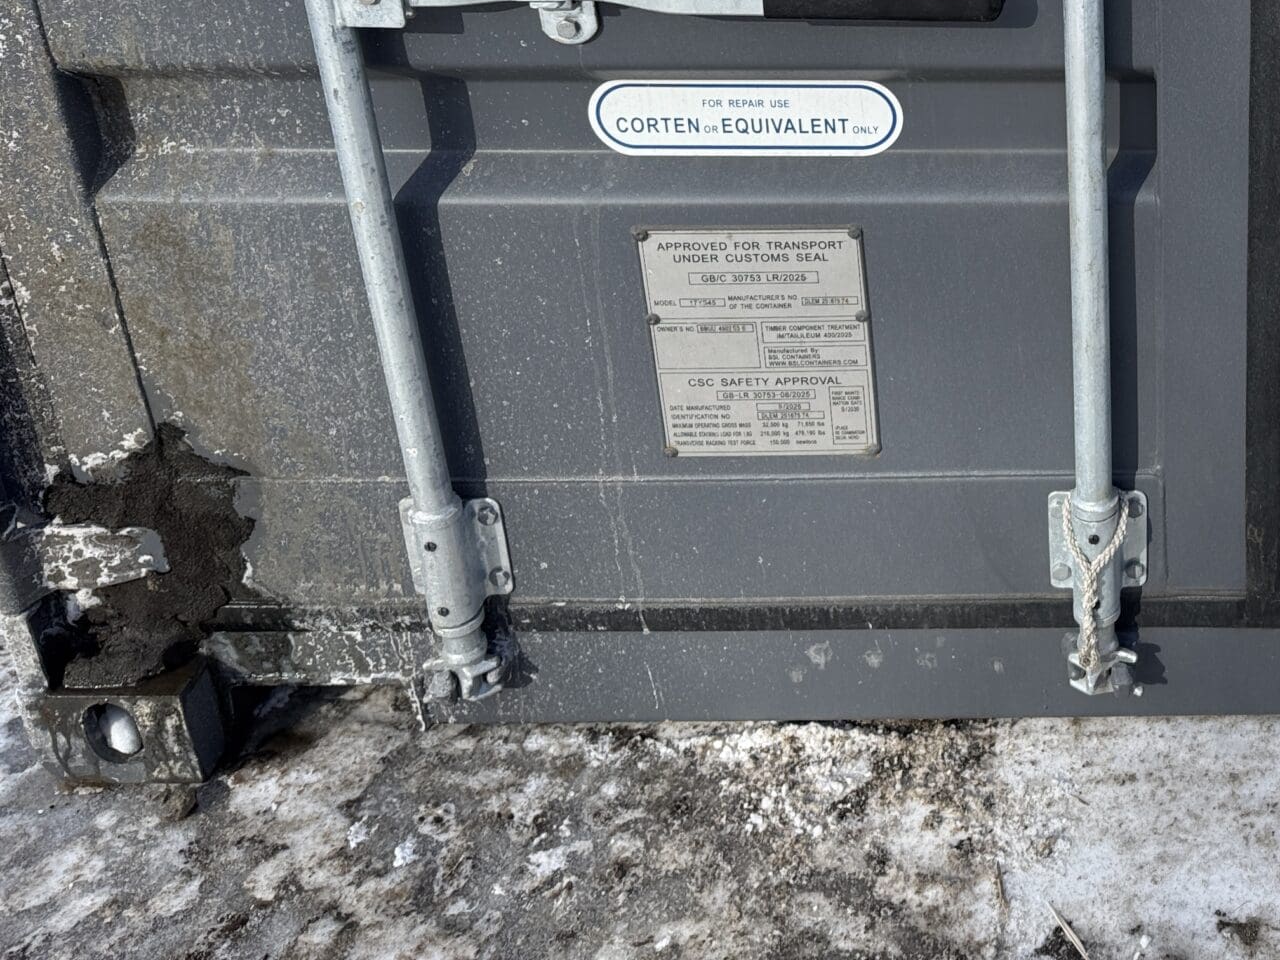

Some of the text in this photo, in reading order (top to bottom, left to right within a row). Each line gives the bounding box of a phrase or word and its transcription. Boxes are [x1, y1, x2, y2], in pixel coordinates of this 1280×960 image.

[702, 99, 790, 108] FOR REPAIR USE
[616, 117, 879, 136] CORTEN OR EQUIVALENT ONLY
[657, 240, 843, 251] APPROVED FOR TRANSPORT
[673, 253, 828, 263] UNDER CUSTOMS SEAL
[701, 273, 807, 283] GB/C 30753 LR/2025
[688, 376, 842, 387] CSC SAFETY APPROVAL
